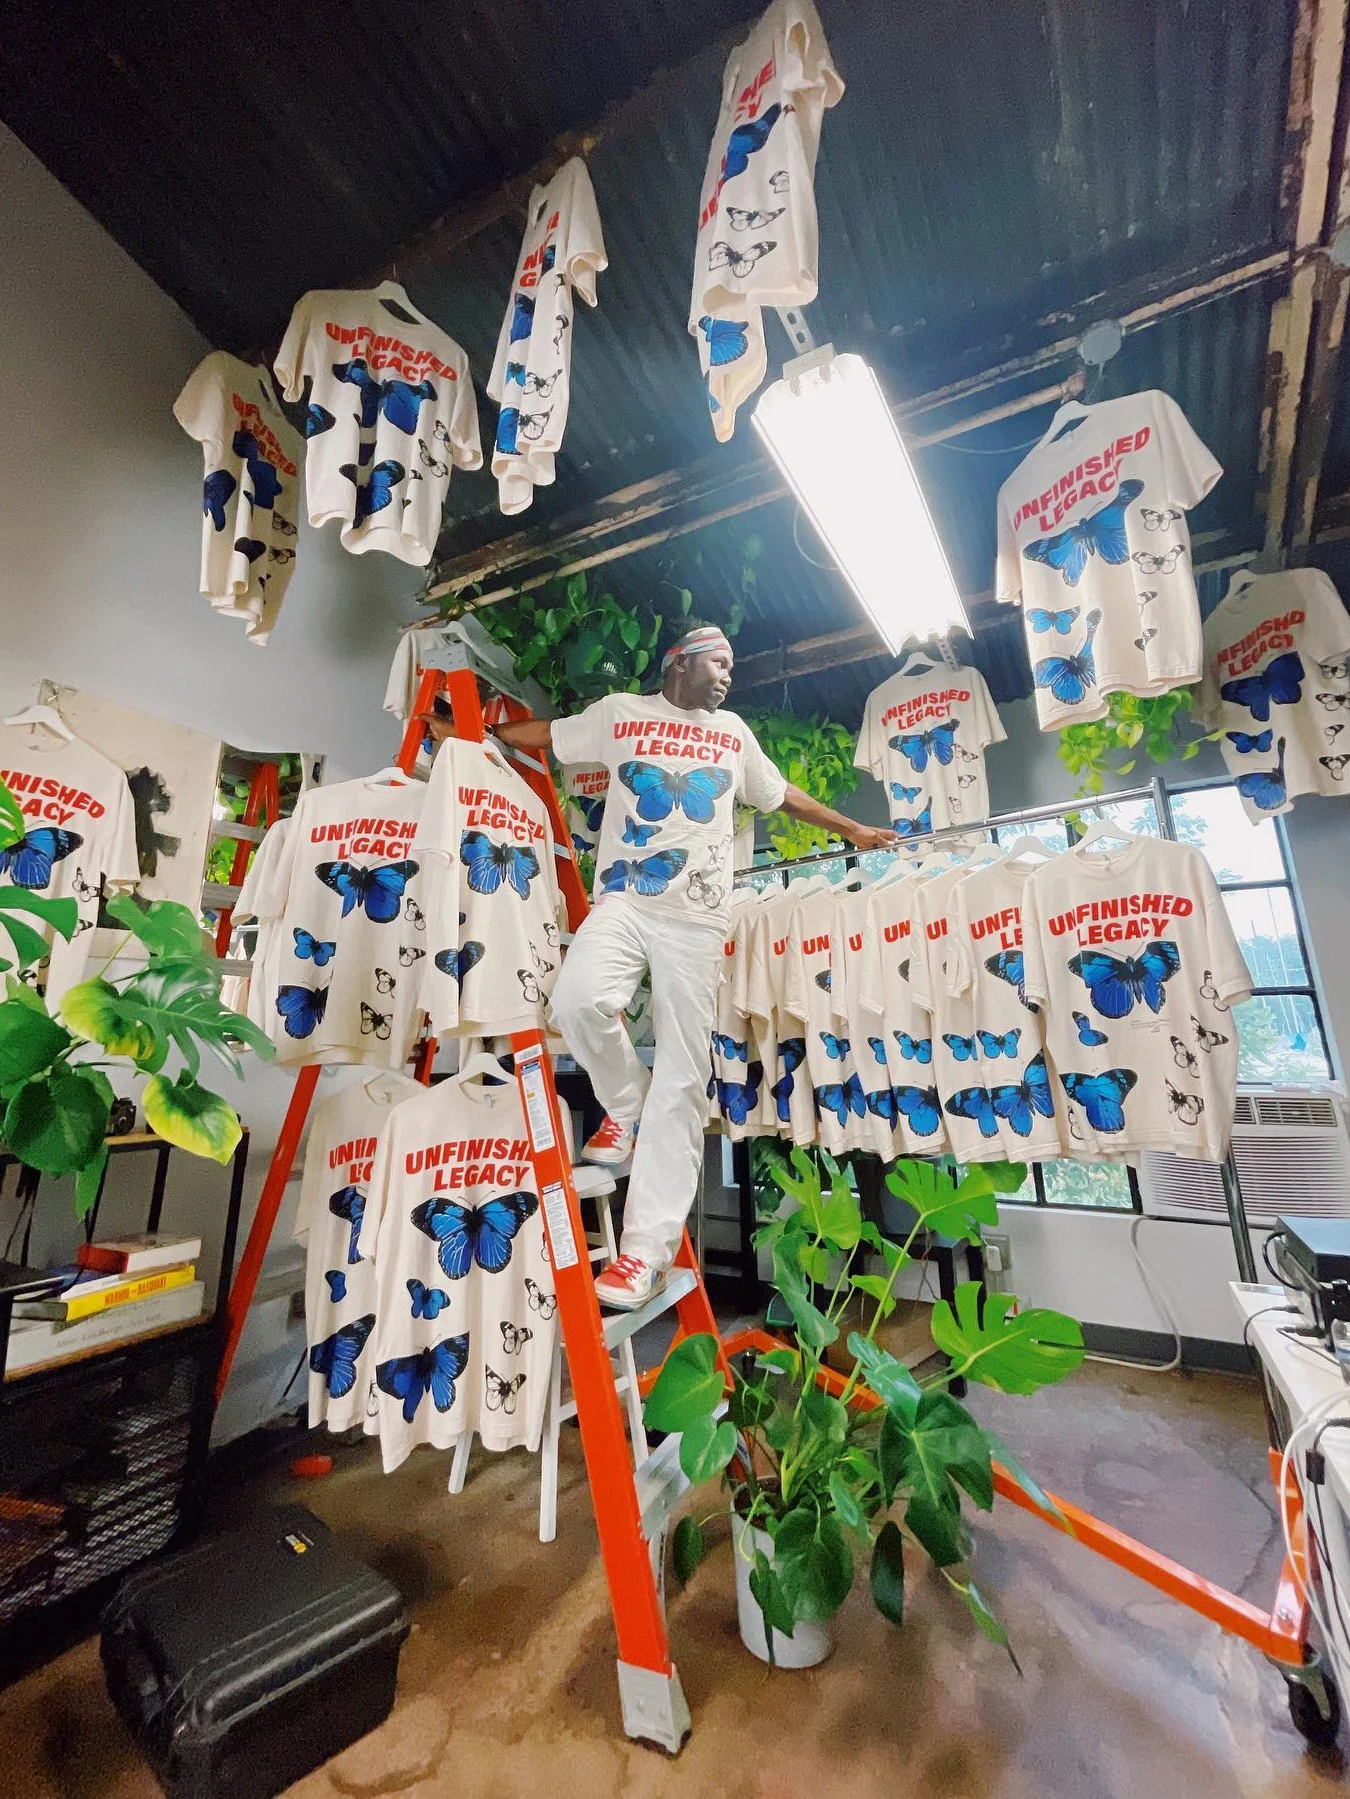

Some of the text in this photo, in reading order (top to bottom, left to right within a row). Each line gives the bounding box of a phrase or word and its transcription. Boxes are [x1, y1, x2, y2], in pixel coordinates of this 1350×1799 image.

[1014, 426, 1151, 531] UNFINISHED
[1040, 458, 1124, 532] LEGACY
[881, 688, 971, 727] UNFINISHED
[897, 702, 952, 731] LEGACY
[613, 721, 742, 753] UNFINISHED
[634, 739, 724, 764] LEGACY
[0, 770, 105, 819] NISHED
[14, 794, 75, 826] ACY
[310, 818, 419, 844] UNFINISH
[337, 836, 412, 861] LGACY
[1048, 893, 1194, 937] UNFINISHED
[1076, 917, 1170, 947] LEGACY
[405, 1137, 533, 1175] UNFINISH
[433, 1163, 530, 1193] LEGACY
